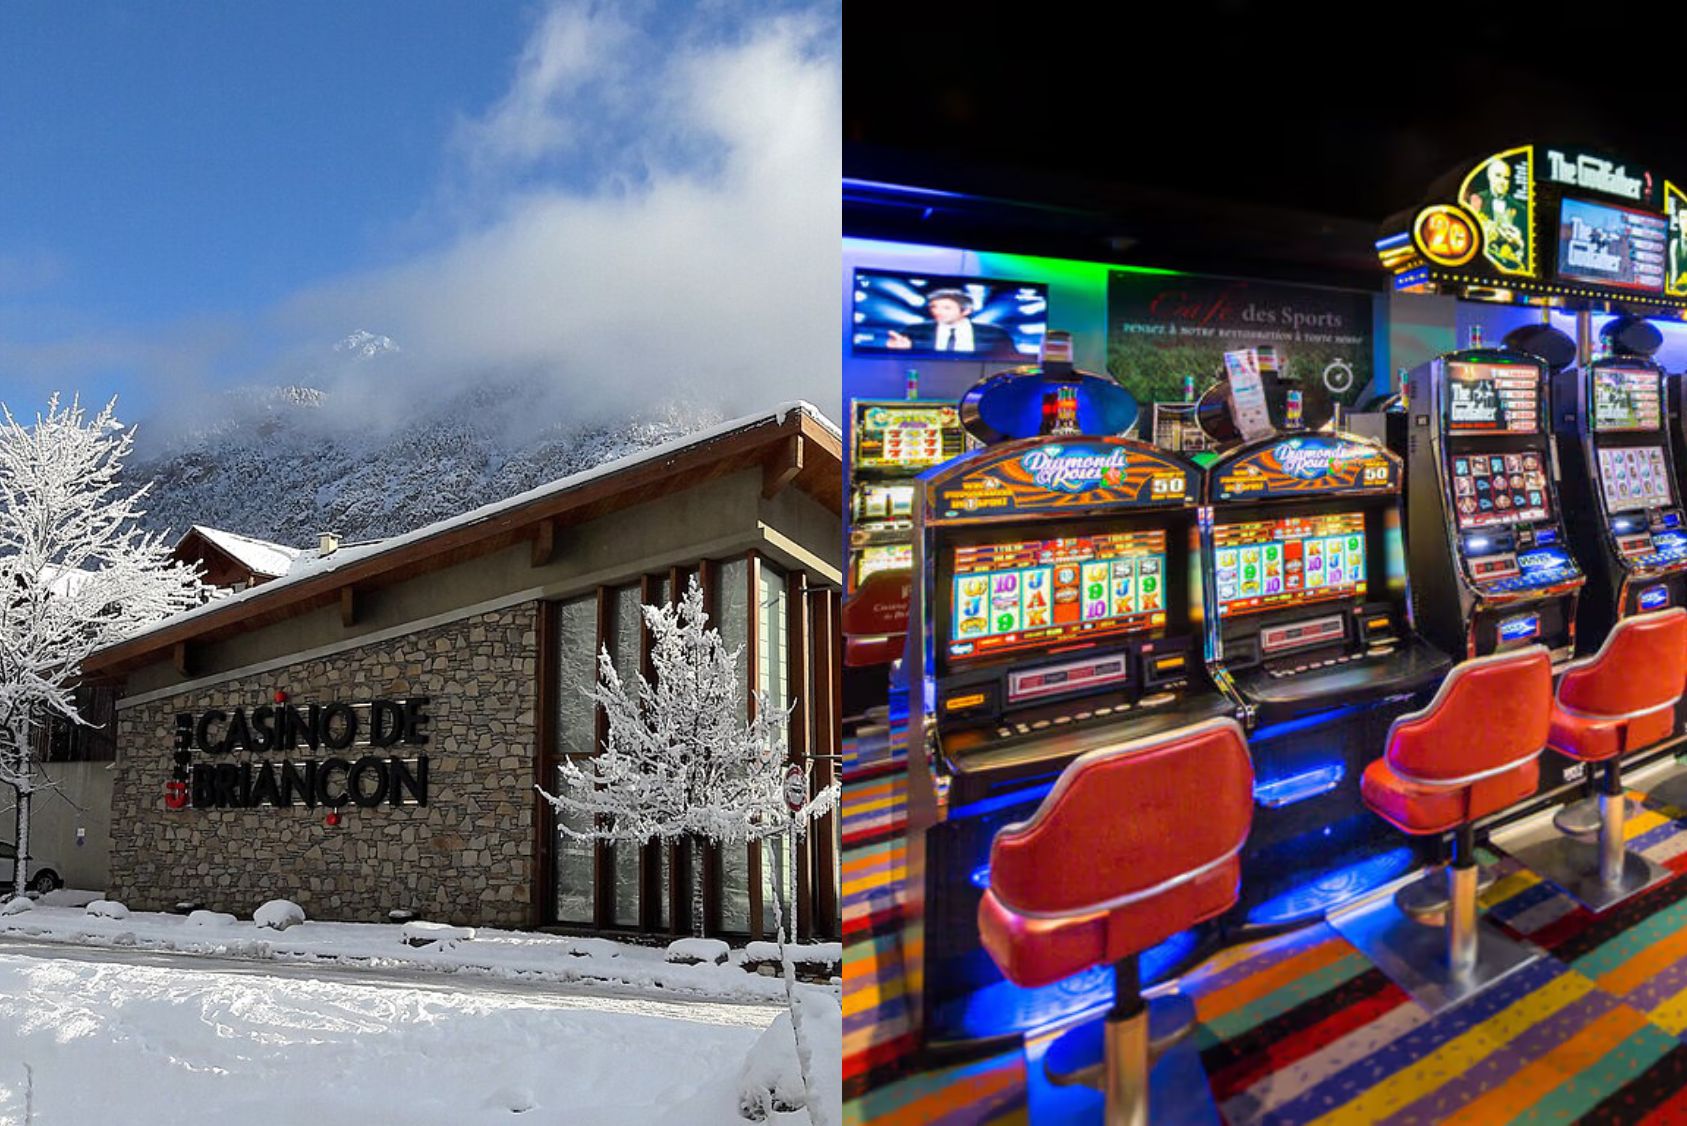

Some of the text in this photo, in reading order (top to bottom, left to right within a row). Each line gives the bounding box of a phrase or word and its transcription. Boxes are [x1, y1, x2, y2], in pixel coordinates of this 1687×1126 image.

[1242, 303, 1276, 323] des
[1282, 306, 1342, 327] Sports
[1365, 467, 1388, 481] 50
[1153, 477, 1185, 493] 50
[963, 597, 981, 617] J
[198, 697, 430, 754] CASINO DE
